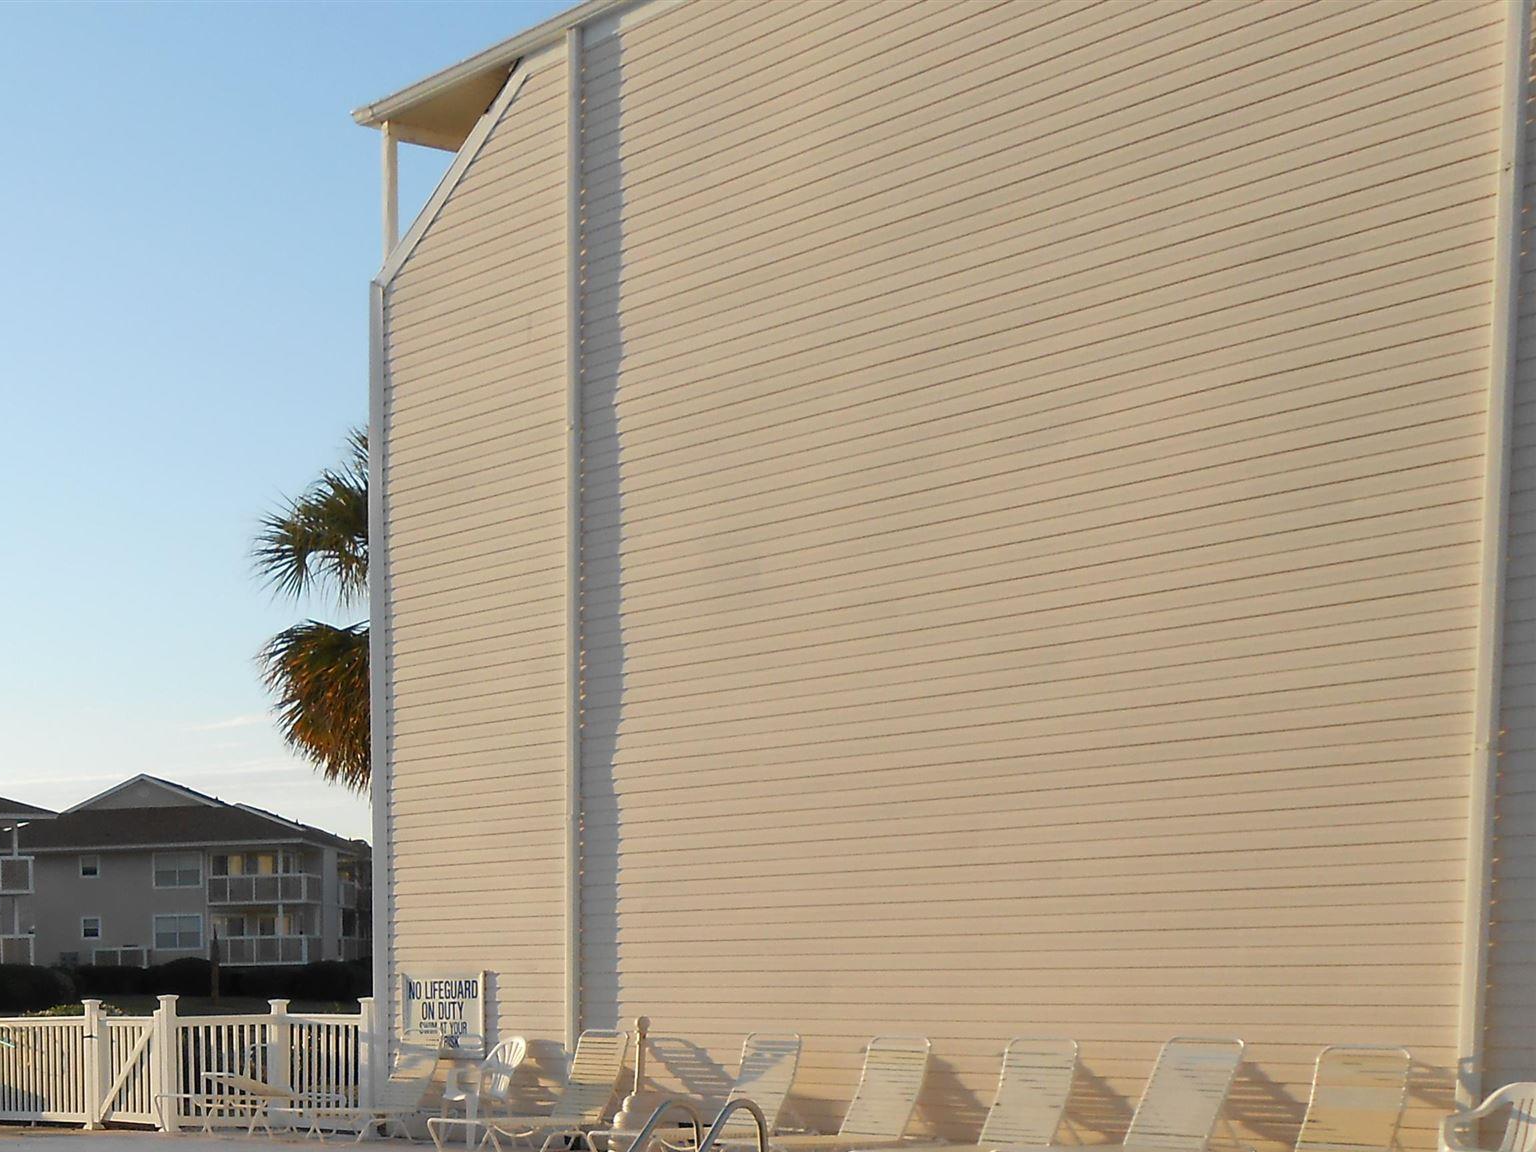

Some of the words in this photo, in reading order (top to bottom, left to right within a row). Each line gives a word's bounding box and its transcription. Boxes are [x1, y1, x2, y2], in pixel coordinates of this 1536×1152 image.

[409, 981, 422, 999] NO
[425, 980, 478, 999] LIFEGUARD
[421, 1002, 435, 1020] ON
[438, 1002, 464, 1020] DUTY
[449, 1022, 468, 1035] YOUR
